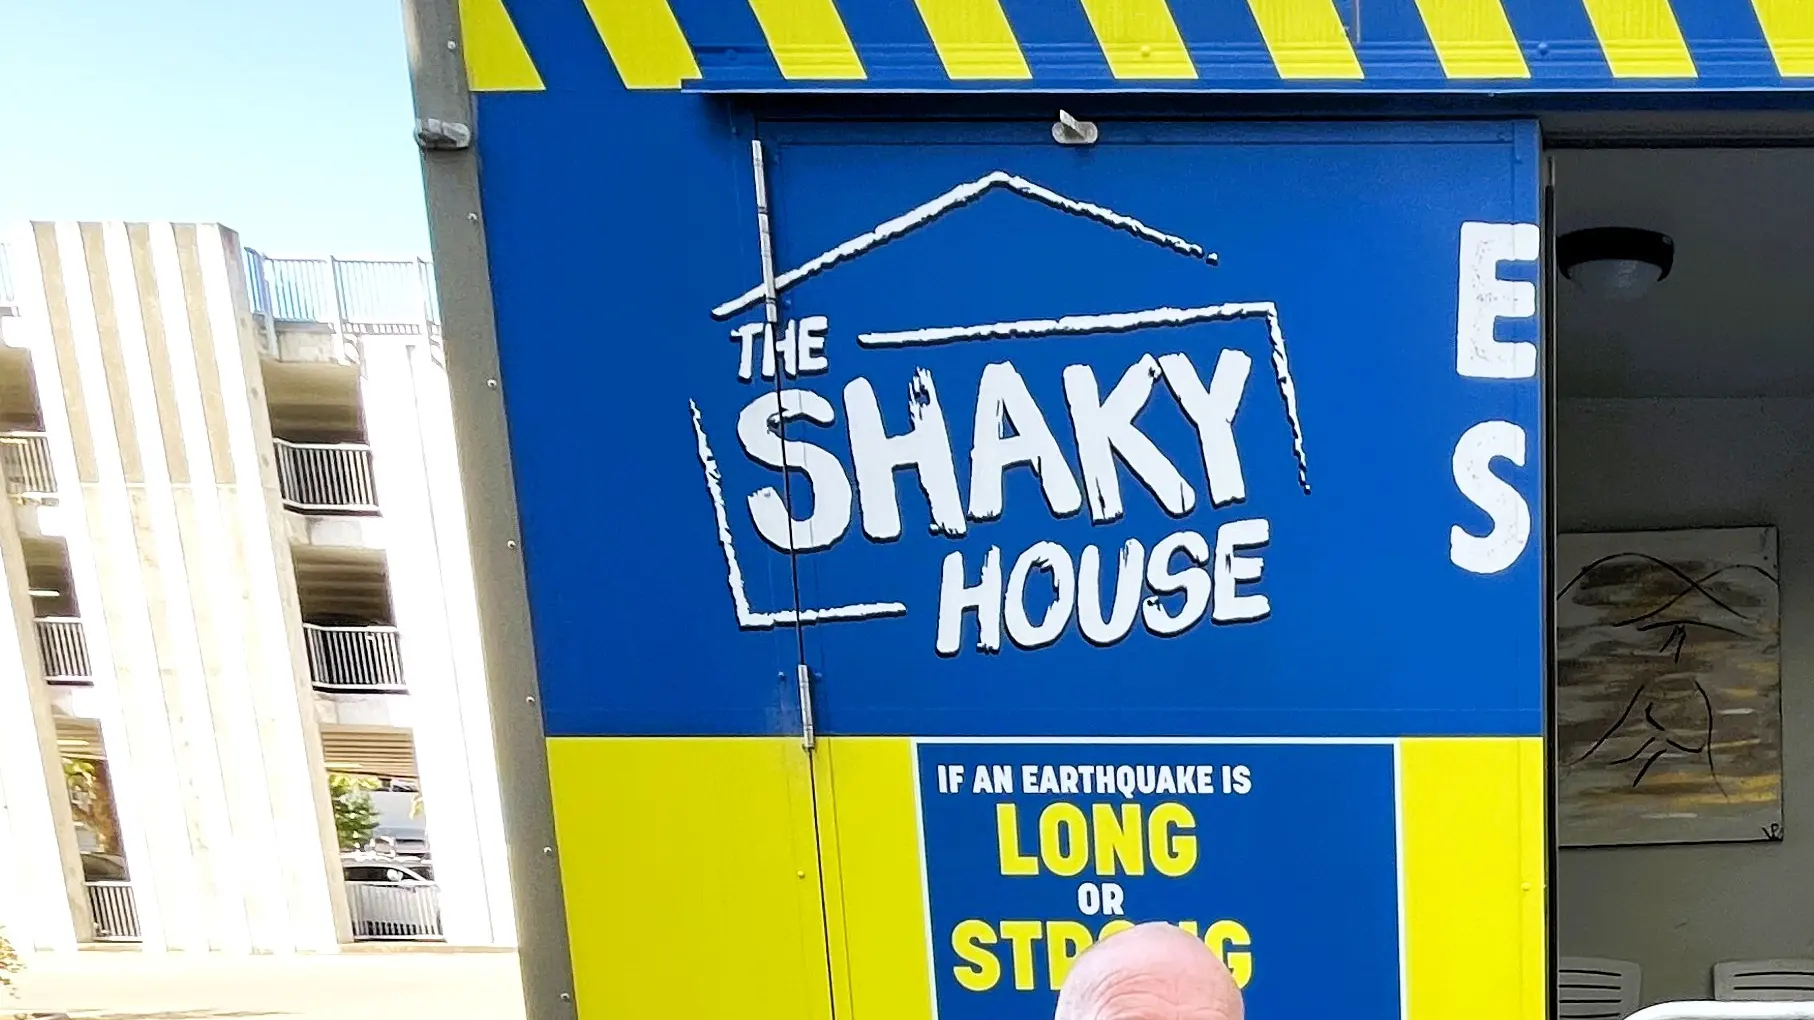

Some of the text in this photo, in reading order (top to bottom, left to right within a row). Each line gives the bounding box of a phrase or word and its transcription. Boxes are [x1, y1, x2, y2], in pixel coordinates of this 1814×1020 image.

[1456, 221, 1540, 378] E
[730, 315, 830, 381] THE
[737, 349, 1253, 551] SHAKY
[1450, 420, 1531, 574] S
[936, 519, 1270, 655] HOUSE
[937, 765, 1251, 799] IF AN EARTHQUAKE IS
[996, 802, 1198, 877] LONG
[1077, 882, 1124, 915] OR
[951, 919, 1252, 991] STRG
